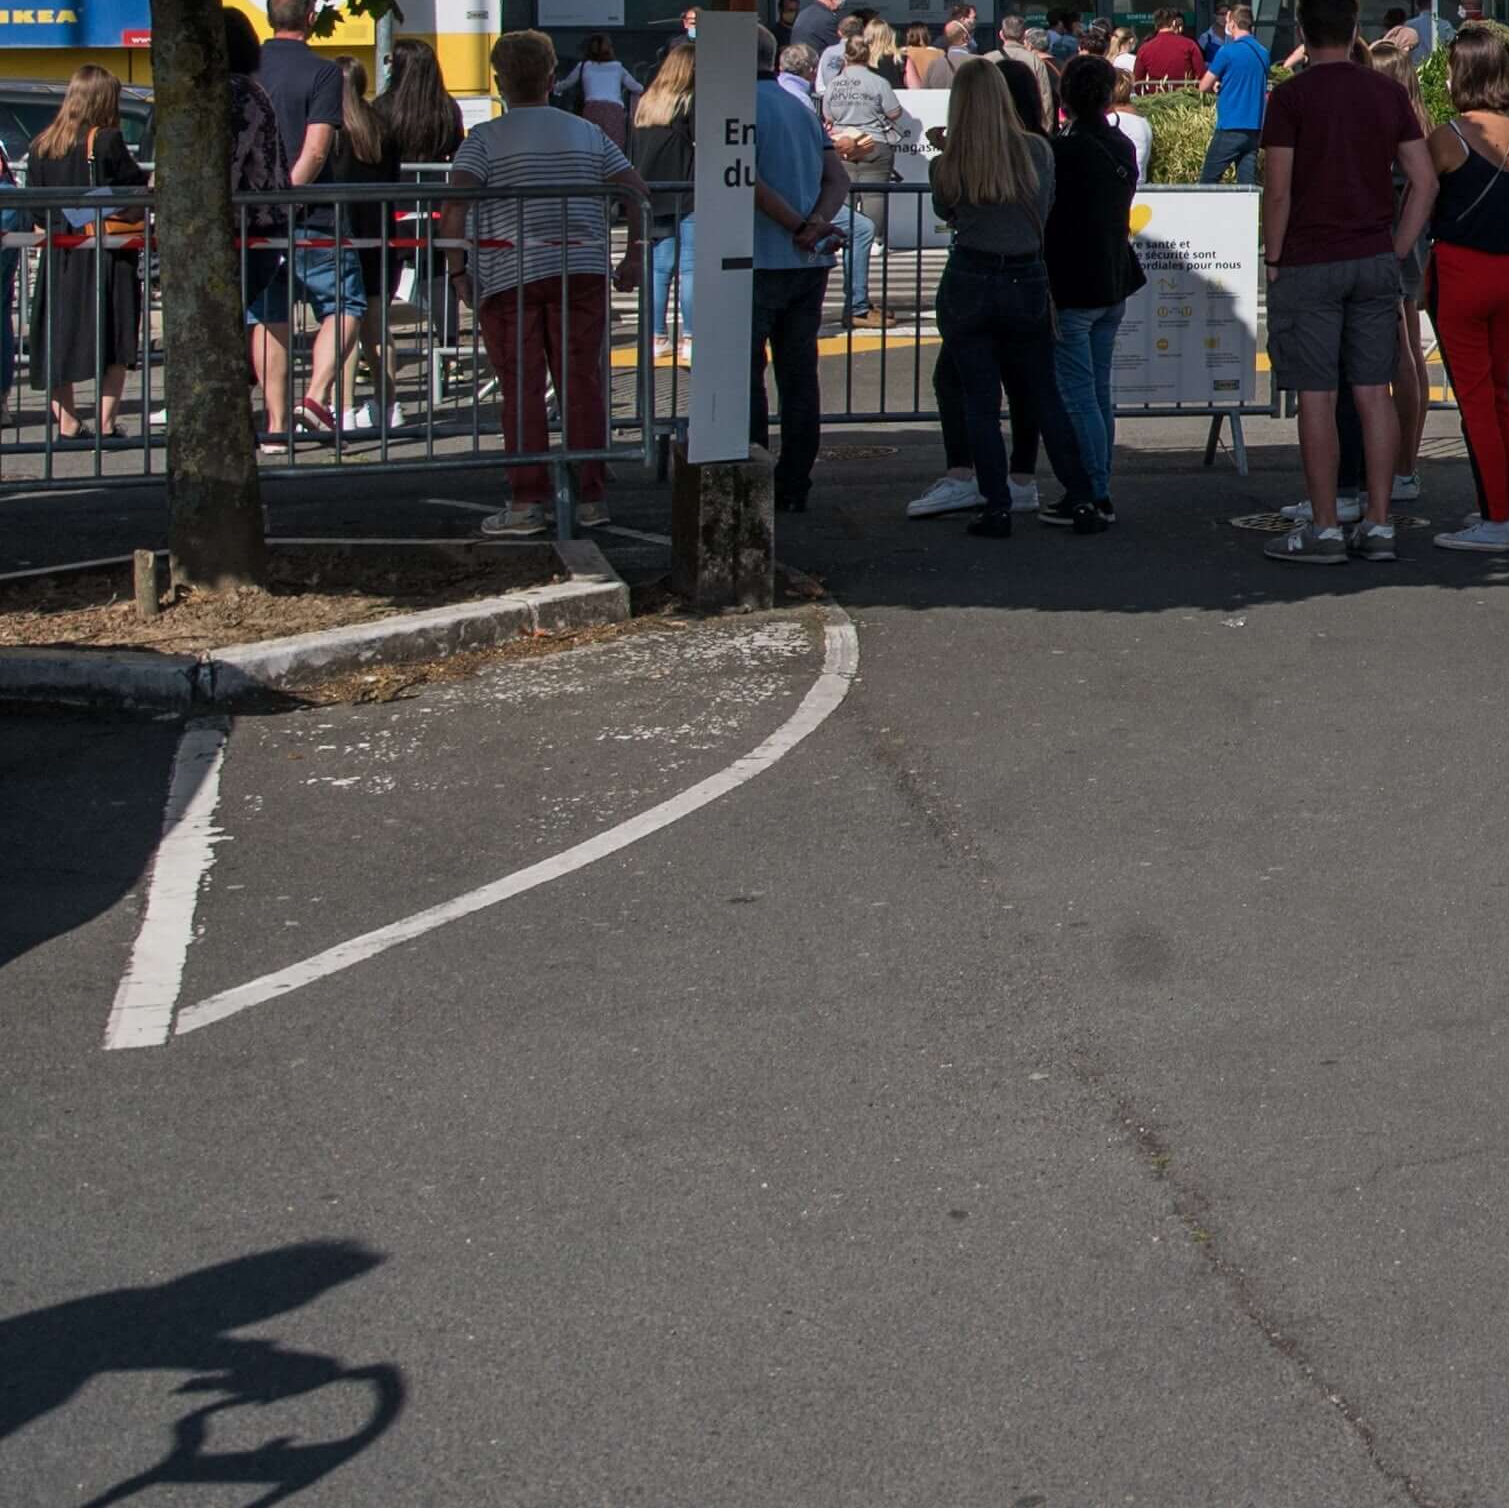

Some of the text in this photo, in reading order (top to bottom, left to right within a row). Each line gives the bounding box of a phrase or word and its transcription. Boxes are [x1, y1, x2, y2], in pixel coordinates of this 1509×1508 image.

[1145, 239, 1177, 249] santé
[1179, 240, 1190, 249] et
[1192, 251, 1217, 259] sont
[1186, 261, 1212, 271] pour
[1215, 261, 1242, 269] nous
